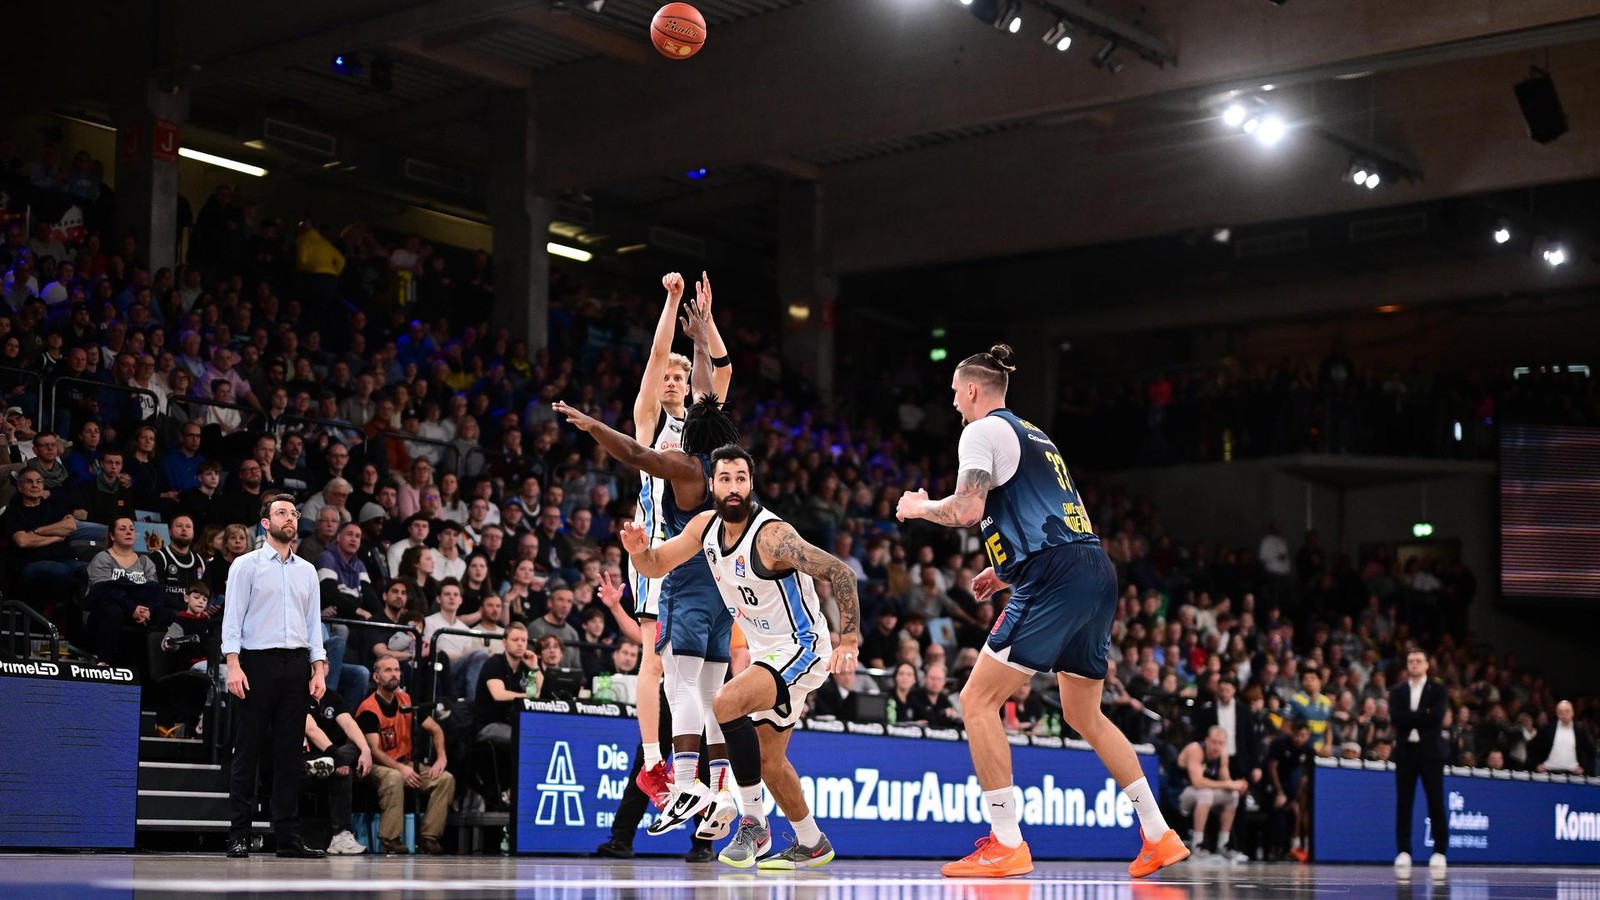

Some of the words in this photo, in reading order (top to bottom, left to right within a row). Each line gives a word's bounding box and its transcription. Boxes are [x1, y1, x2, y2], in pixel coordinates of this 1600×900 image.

[161, 131, 173, 152] J
[738, 586, 758, 606] 13
[0, 661, 59, 676] rimeLED
[70, 664, 134, 681] PrimeLED
[523, 698, 570, 713] PrimeLED
[575, 702, 620, 716] PrimeLED
[597, 743, 629, 771] Die
